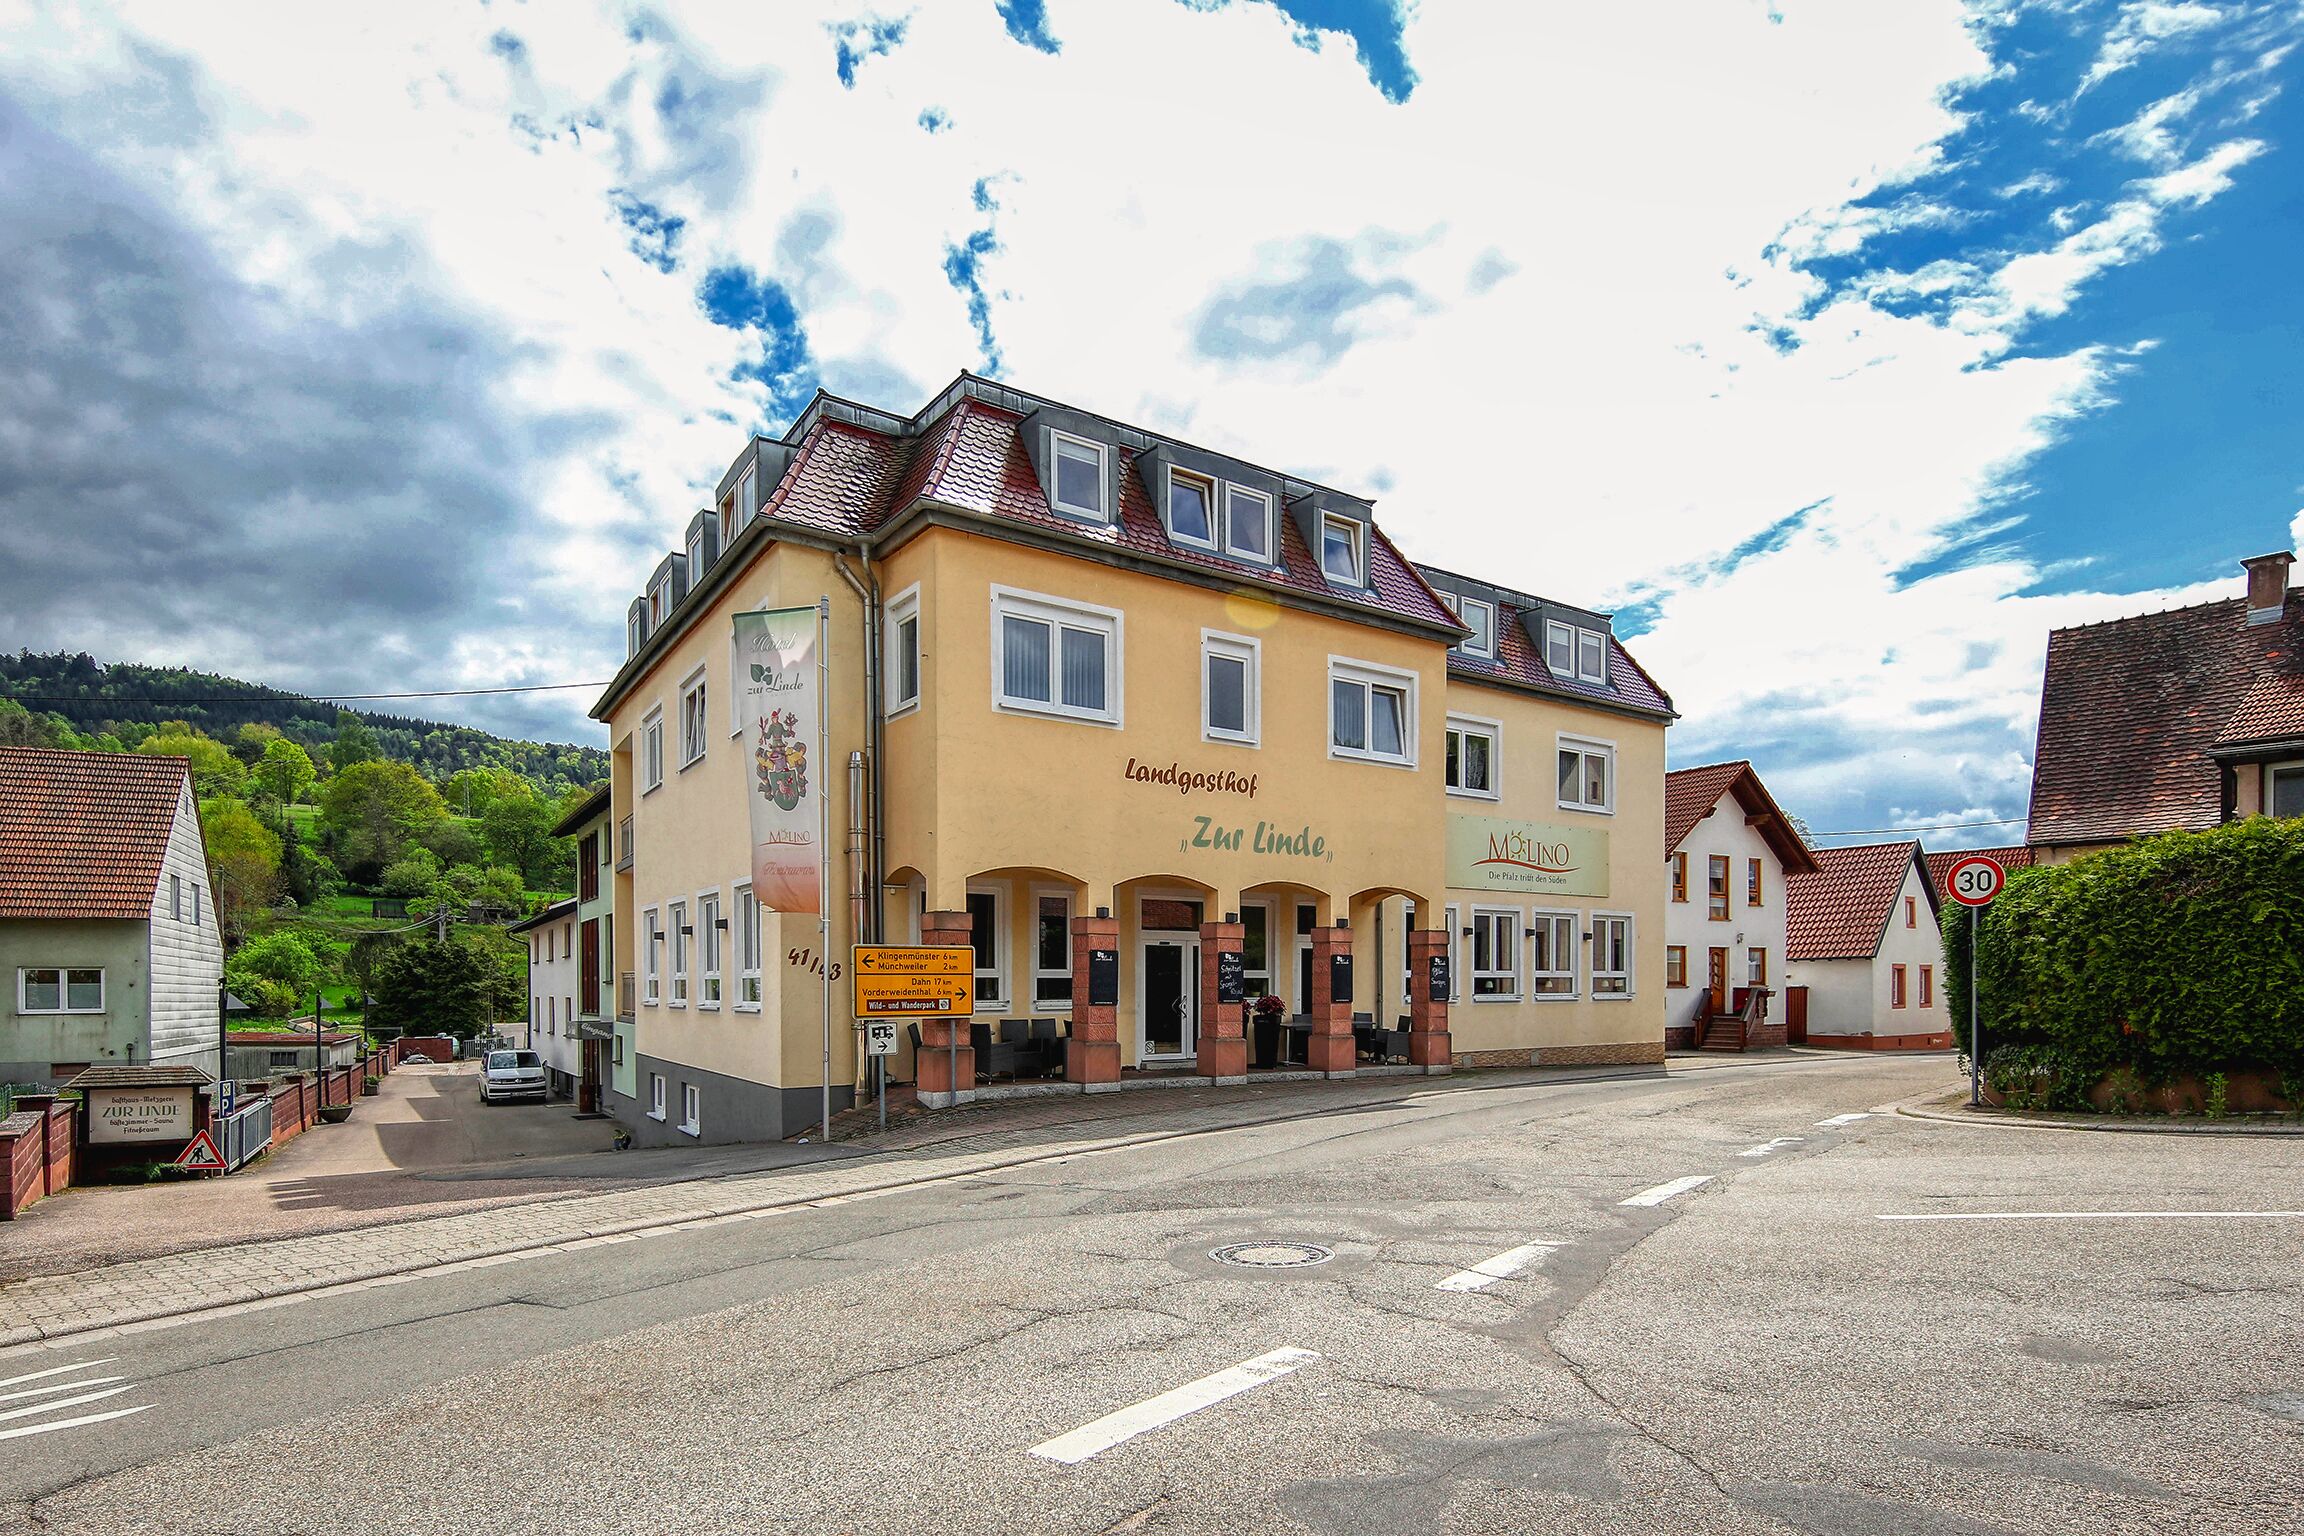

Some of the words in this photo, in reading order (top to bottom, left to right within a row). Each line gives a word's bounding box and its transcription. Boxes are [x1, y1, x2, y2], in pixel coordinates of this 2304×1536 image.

[751, 632, 797, 652] Hotel
[747, 686, 764, 695] zur
[766, 671, 804, 693] Linde
[1123, 757, 1258, 799] Landgasthof
[1488, 870, 1501, 880] Die
[1502, 871, 1519, 881] Pfalz
[1535, 874, 1547, 883] den
[1548, 875, 1567, 885] Süden
[1958, 869, 1992, 893] 30
[877, 951, 940, 961] Klingenmünster
[942, 952, 948, 961] 6
[877, 962, 928, 970] Münchweiler
[943, 962, 948, 970] 2
[911, 978, 931, 986] Dahn
[934, 978, 942, 986] 17
[862, 988, 931, 996] Vorderweidenthal
[936, 988, 942, 996] 6
[868, 1001, 886, 1010] Wild-
[901, 1001, 936, 1010] Wanderpark
[102, 1106, 134, 1118] ZUR
[139, 1104, 181, 1117] LINDE
[222, 1098, 229, 1116] P
